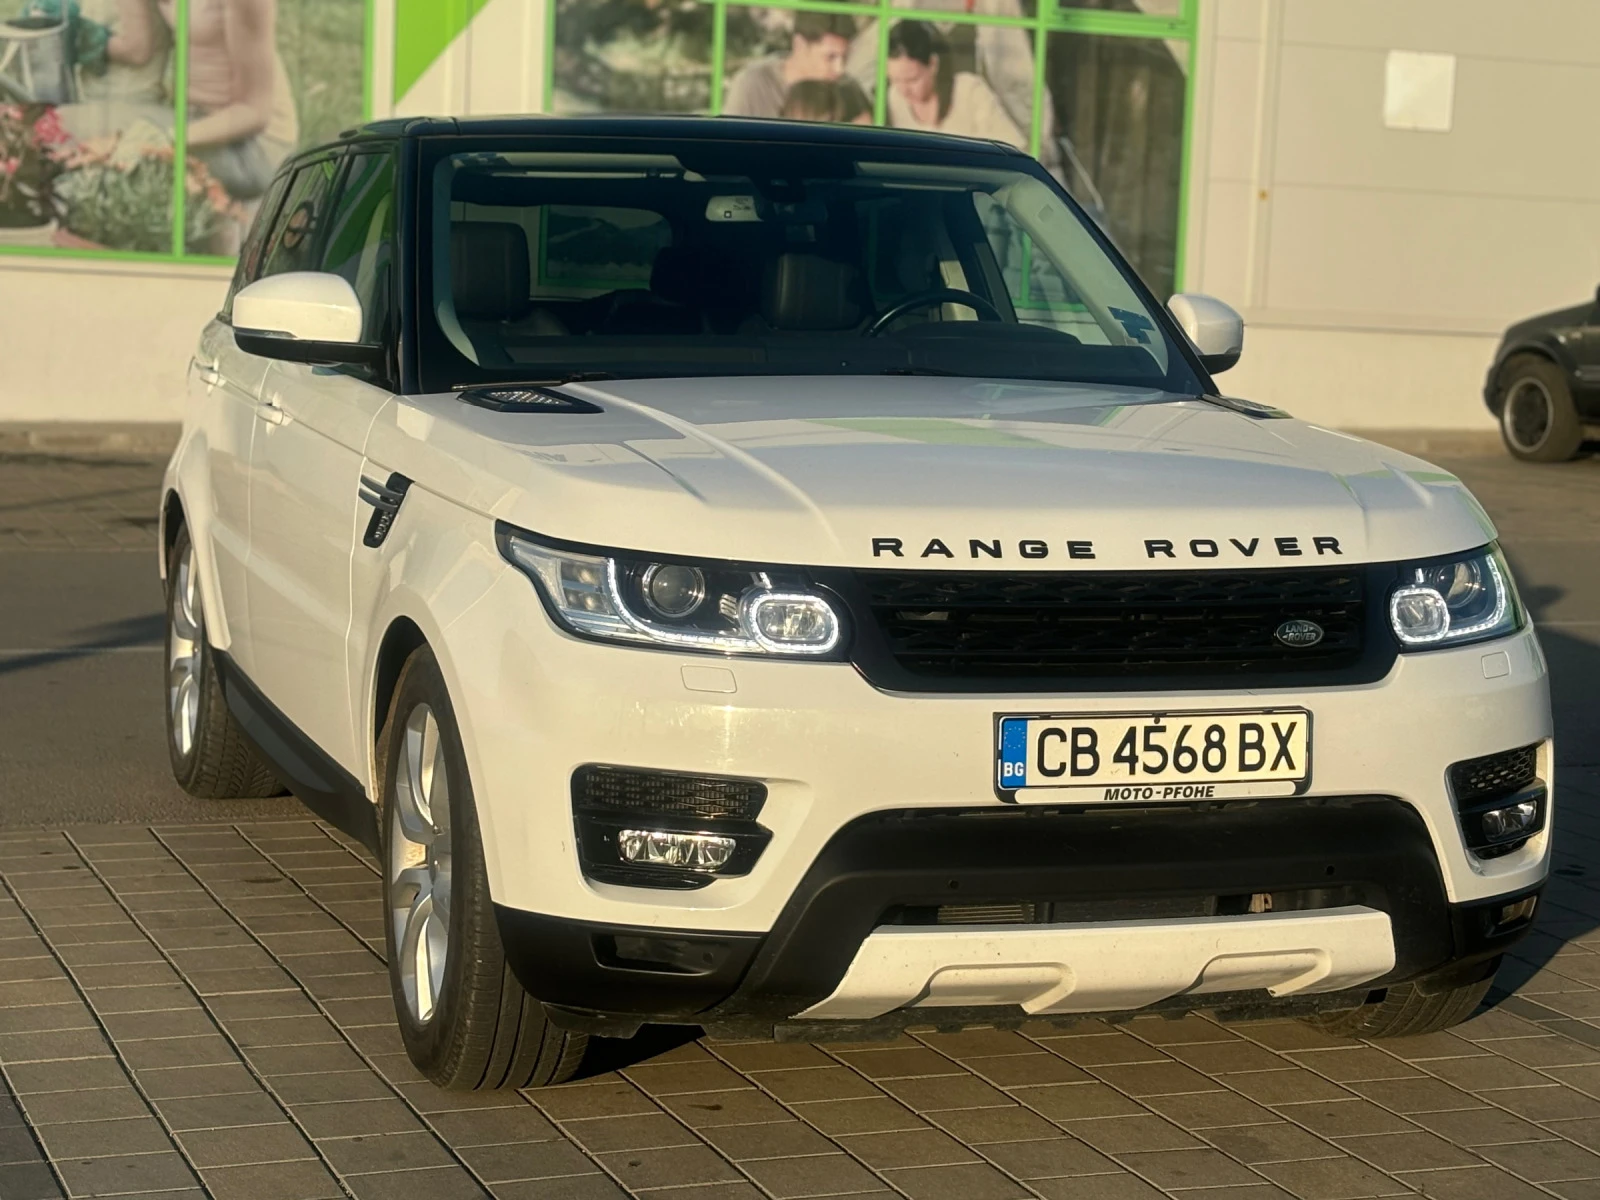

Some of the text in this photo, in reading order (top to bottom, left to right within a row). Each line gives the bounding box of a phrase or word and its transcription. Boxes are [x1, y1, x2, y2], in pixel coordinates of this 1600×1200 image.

[871, 536, 1344, 560] RANGE ROVER
[1285, 624, 1309, 633] LAND
[1288, 632, 1316, 641] ROVER
[1036, 721, 1298, 778] CB 4568 BX
[1003, 761, 1025, 778] BG
[1103, 785, 1215, 801] MOTO-PFOHE
